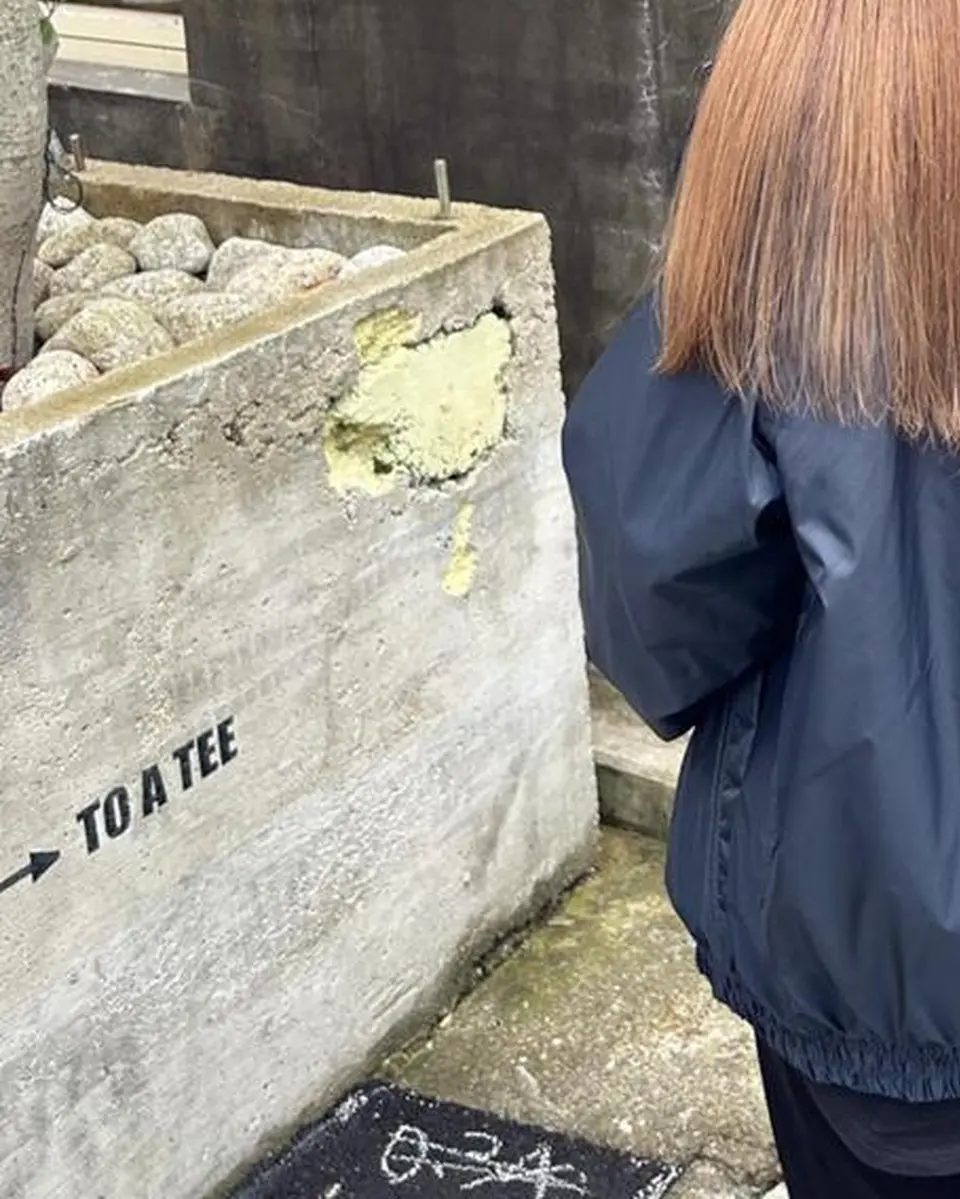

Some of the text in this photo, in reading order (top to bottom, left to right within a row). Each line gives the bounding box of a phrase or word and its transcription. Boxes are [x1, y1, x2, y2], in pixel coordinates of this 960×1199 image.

[76, 714, 238, 855] TO A TEE
